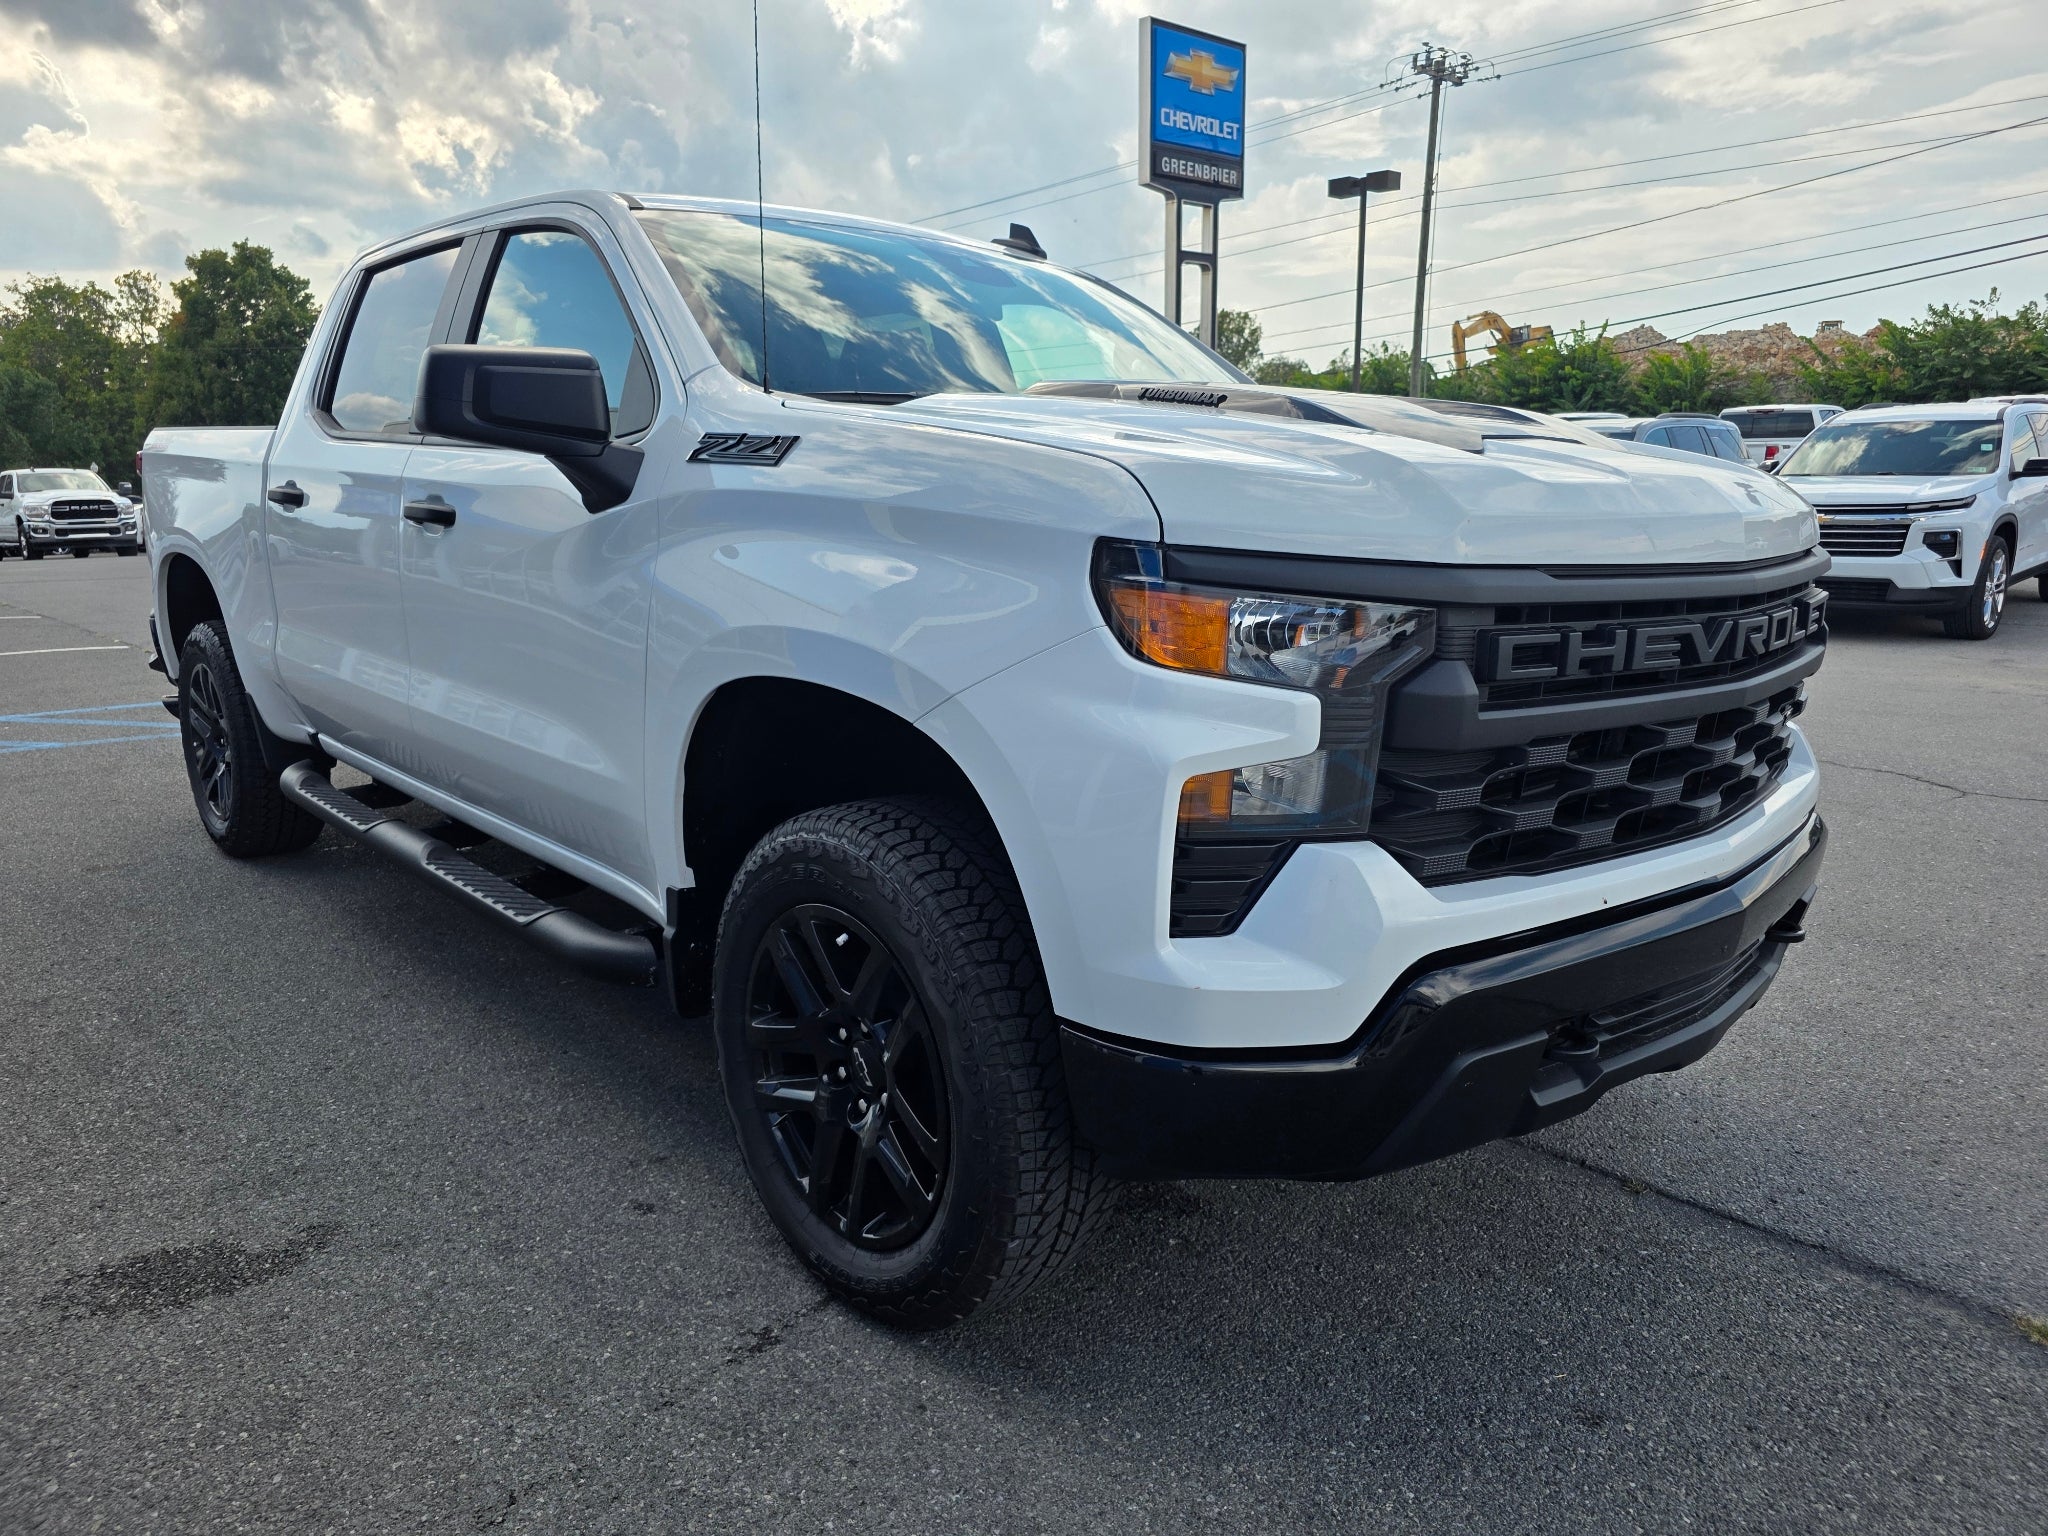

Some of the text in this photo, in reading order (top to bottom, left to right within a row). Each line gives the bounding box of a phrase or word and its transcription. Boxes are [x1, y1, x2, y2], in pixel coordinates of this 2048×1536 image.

[1160, 107, 1239, 141] CHEVROLET
[1161, 156, 1238, 185] GREENBRIER
[1138, 387, 1227, 408] TURBOMAX
[687, 432, 800, 467] Z71
[1493, 589, 1829, 682] CHEVROLE
